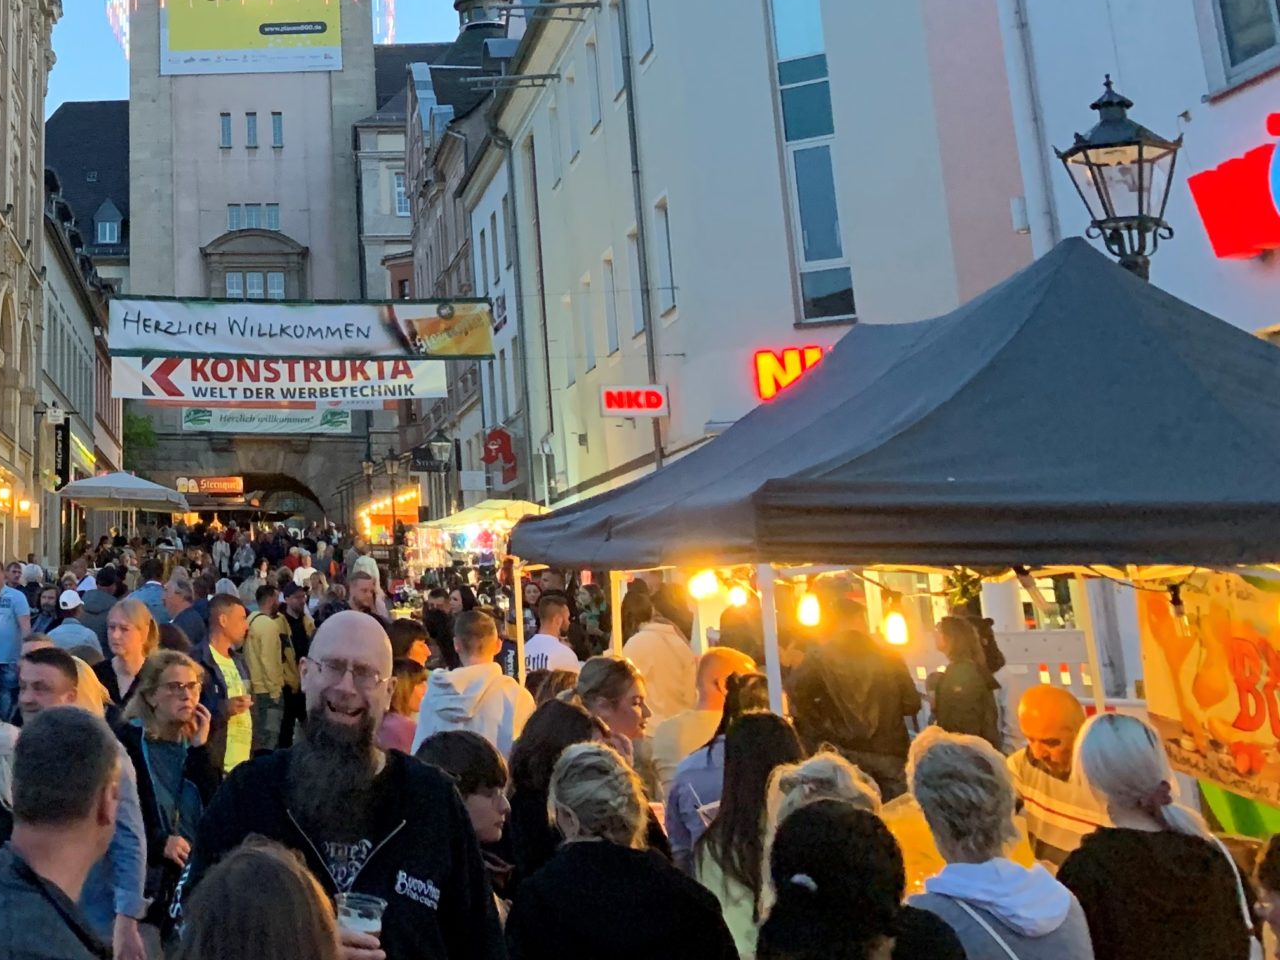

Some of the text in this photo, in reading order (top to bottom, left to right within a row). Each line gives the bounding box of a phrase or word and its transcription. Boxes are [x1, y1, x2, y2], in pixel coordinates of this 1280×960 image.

[227, 316, 372, 340] WILLKOMMEN
[190, 357, 414, 383] KONSTRUKTA
[192, 383, 416, 400] WELT DER WERBETECHNIK
[605, 390, 664, 410] NKD
